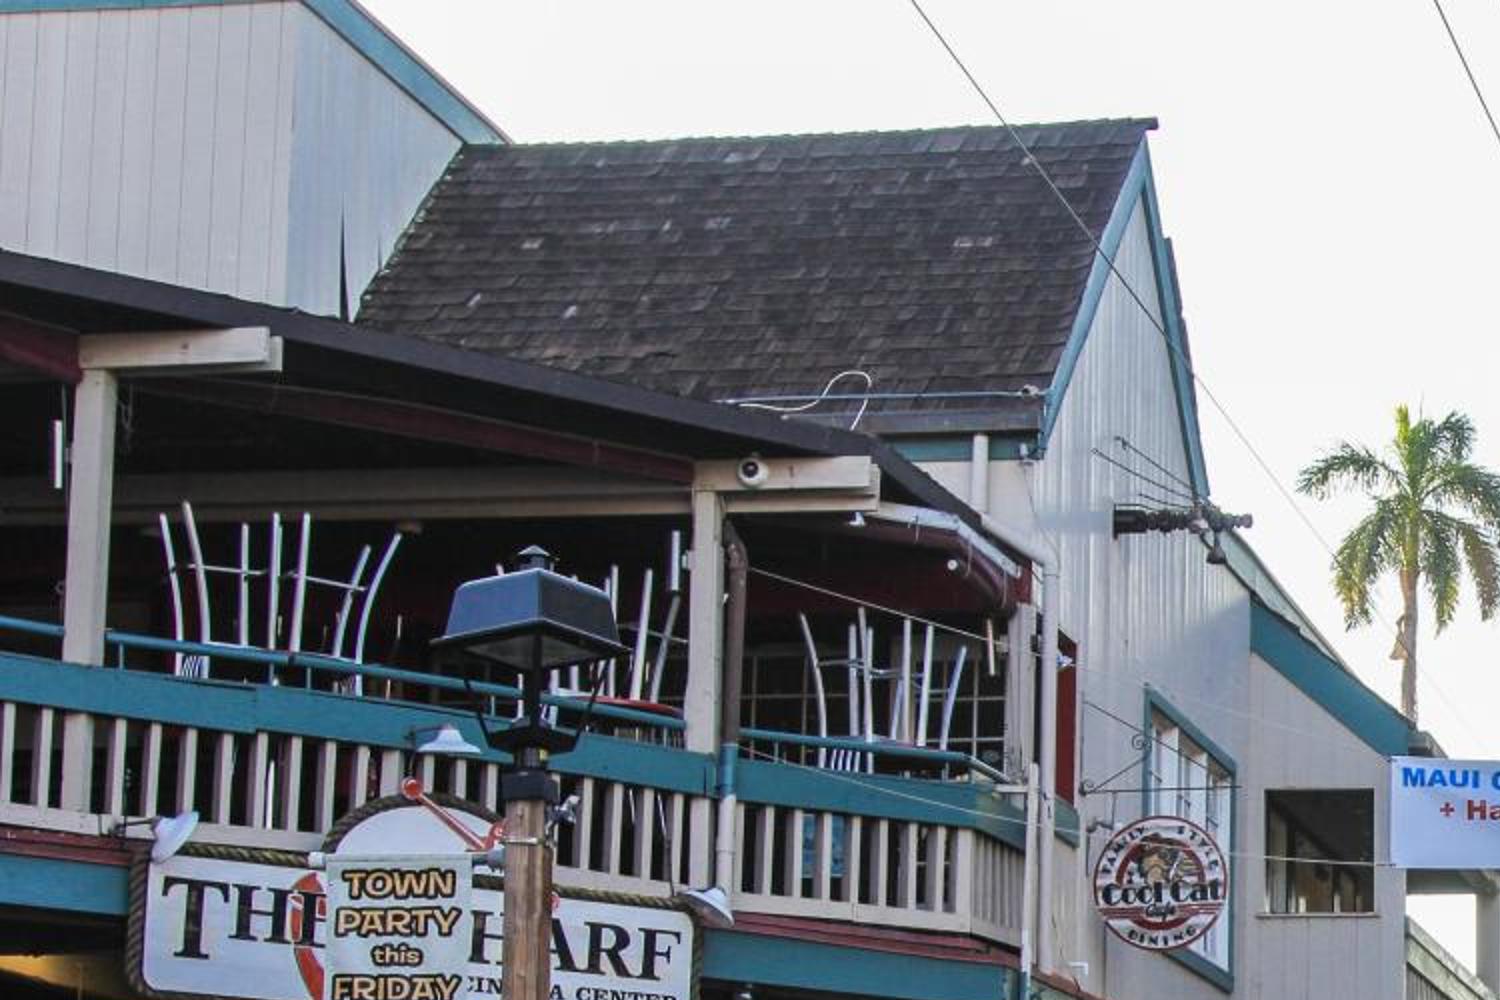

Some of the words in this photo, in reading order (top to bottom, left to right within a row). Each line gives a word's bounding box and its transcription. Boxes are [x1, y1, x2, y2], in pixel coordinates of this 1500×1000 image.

[1401, 767, 1480, 789] MAUI
[1440, 801, 1455, 817] +
[341, 867, 457, 900] TOWN
[1101, 882, 1164, 906] Cool
[1169, 878, 1220, 902] Cat
[335, 906, 462, 938] PARTY
[467, 909, 682, 981] HARF
[1127, 928, 1198, 946] DINING
[370, 943, 423, 967] this
